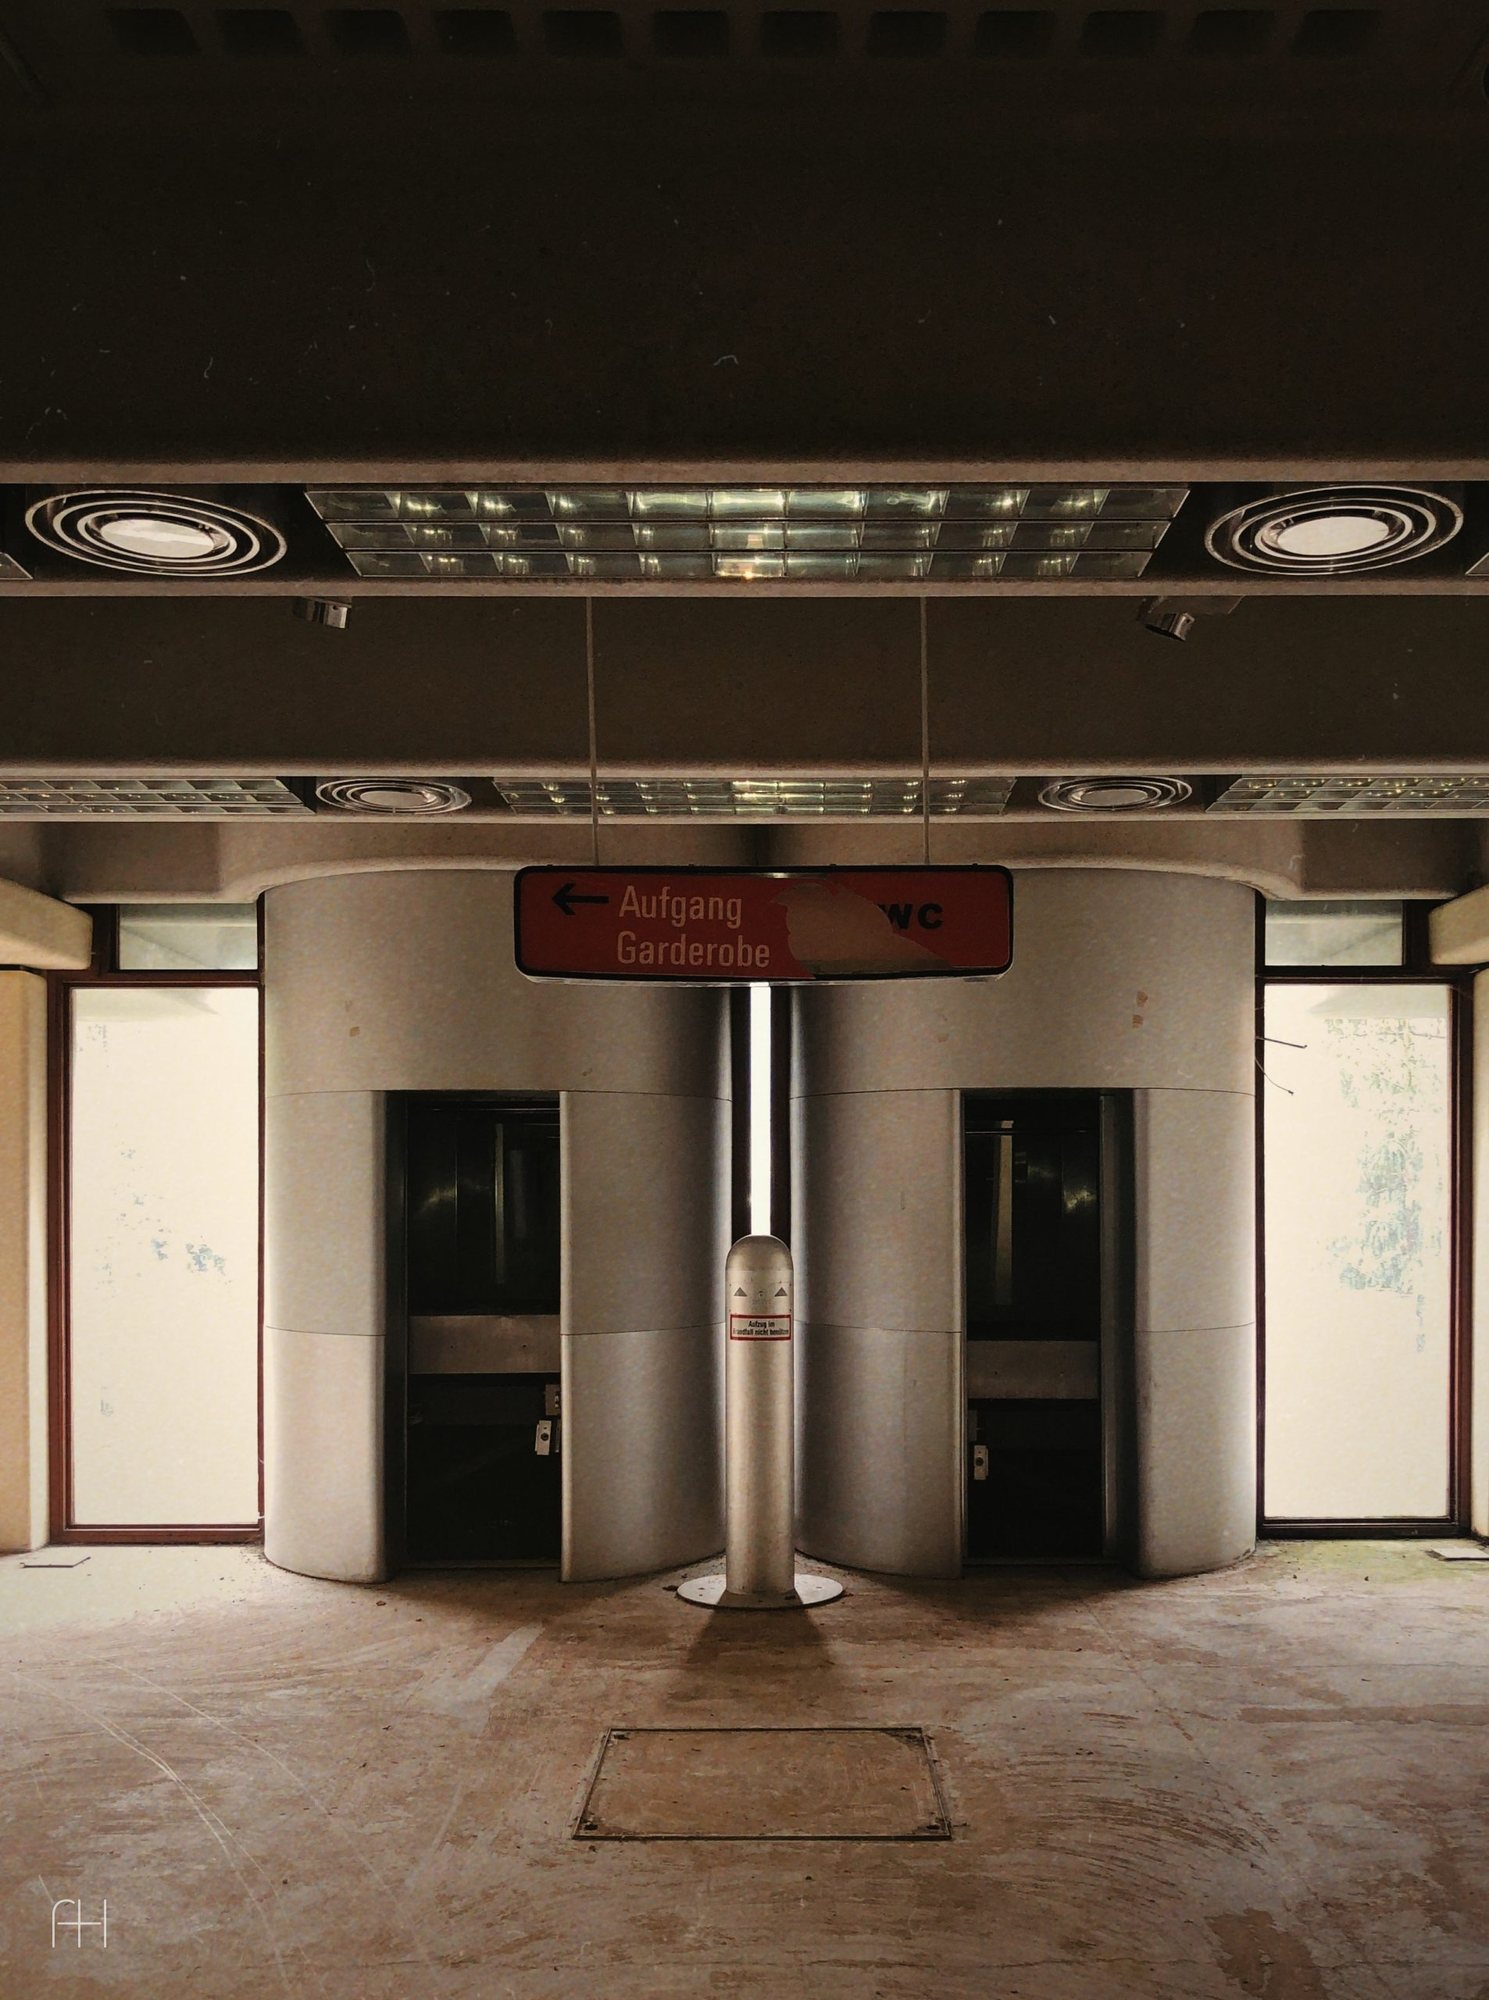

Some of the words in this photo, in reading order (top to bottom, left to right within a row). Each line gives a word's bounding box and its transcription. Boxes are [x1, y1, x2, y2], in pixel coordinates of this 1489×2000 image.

[619, 885, 742, 928] Aufgang
[877, 903, 944, 929] WC
[617, 930, 770, 968] Garderobe
[748, 1320, 767, 1328] Aufzug
